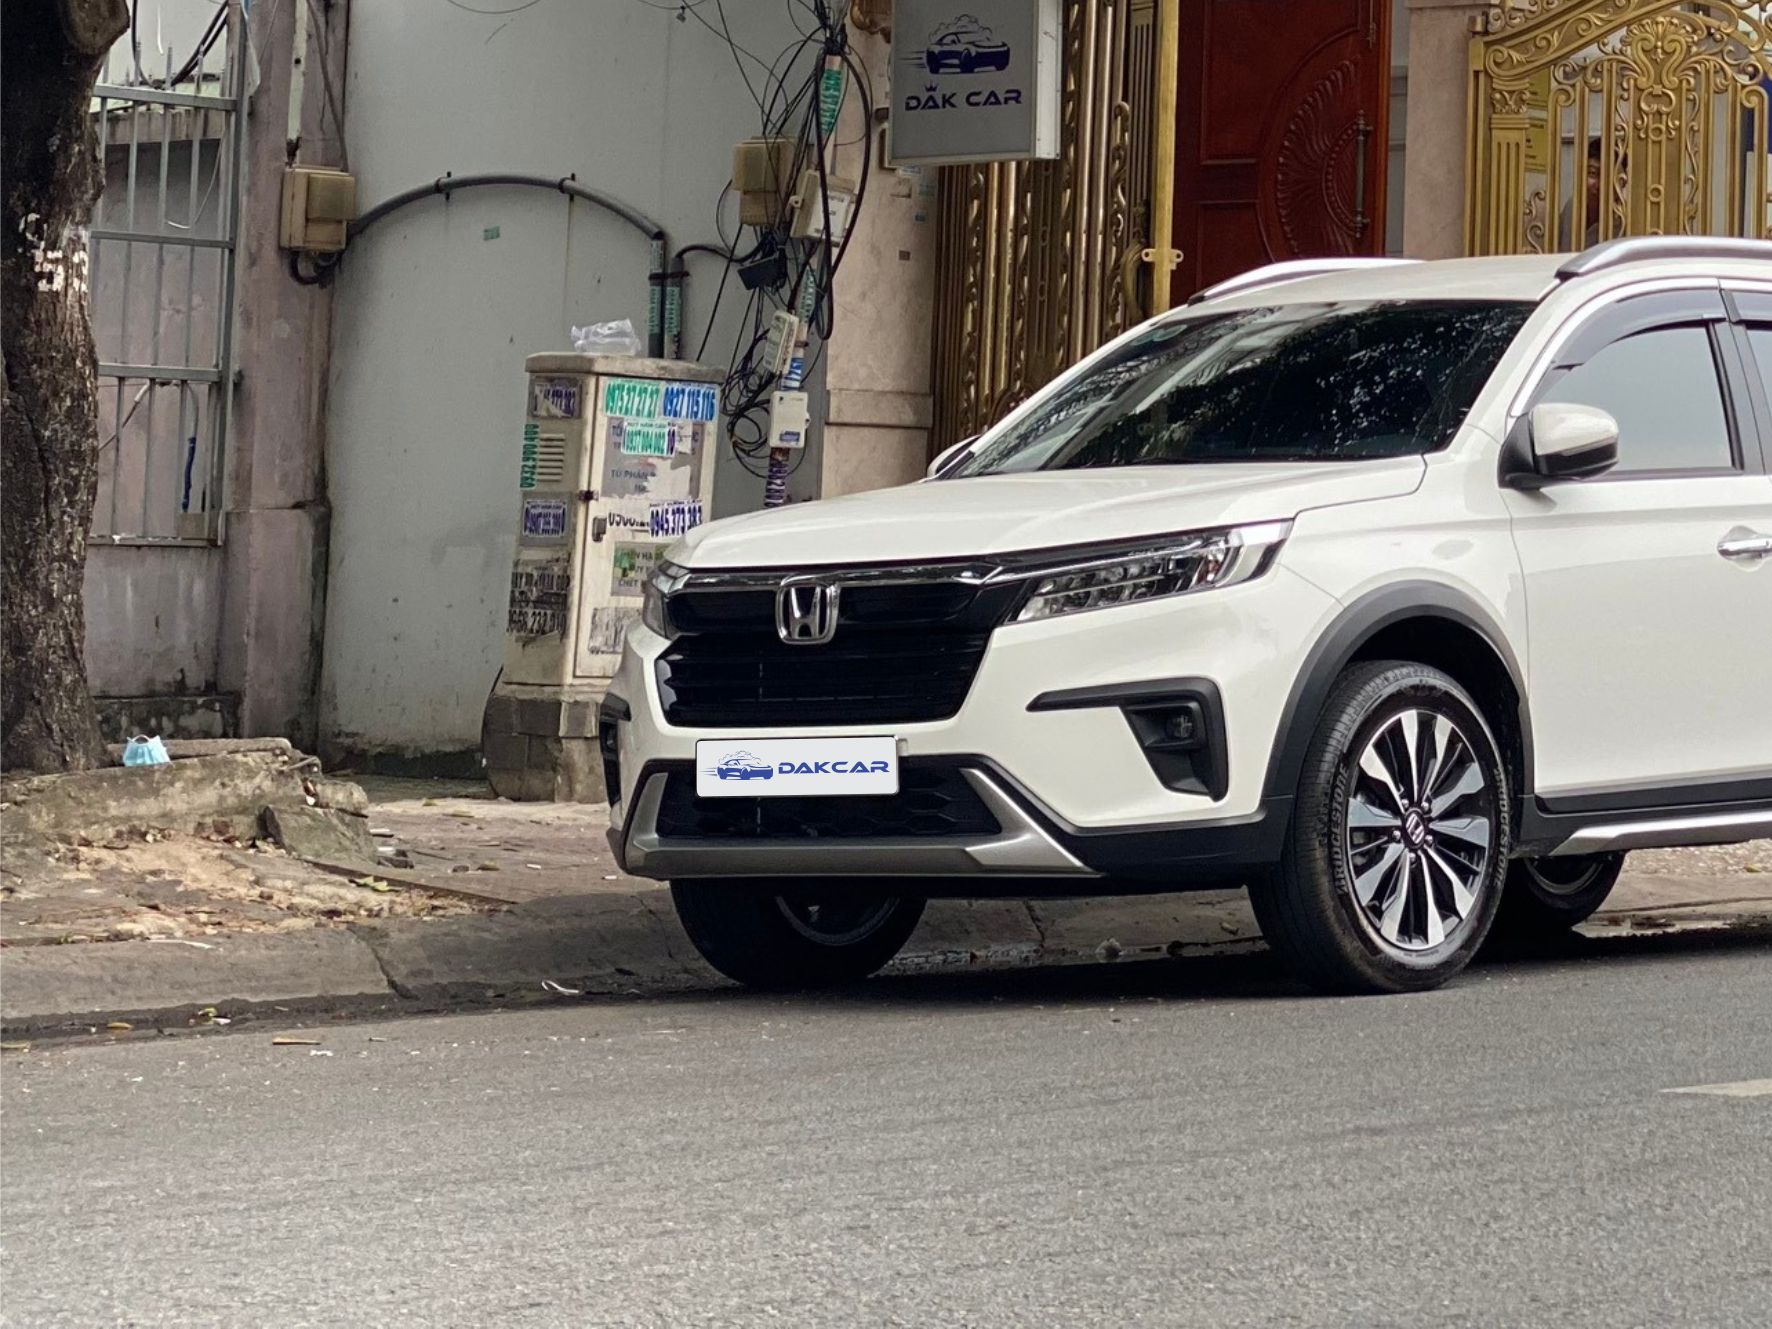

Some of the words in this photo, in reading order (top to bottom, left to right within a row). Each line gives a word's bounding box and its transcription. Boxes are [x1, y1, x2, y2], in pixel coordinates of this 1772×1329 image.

[965, 88, 1022, 106] CAR
[778, 761, 890, 775] DAKCAR
[1330, 763, 1350, 896] BRIDGESTONE
